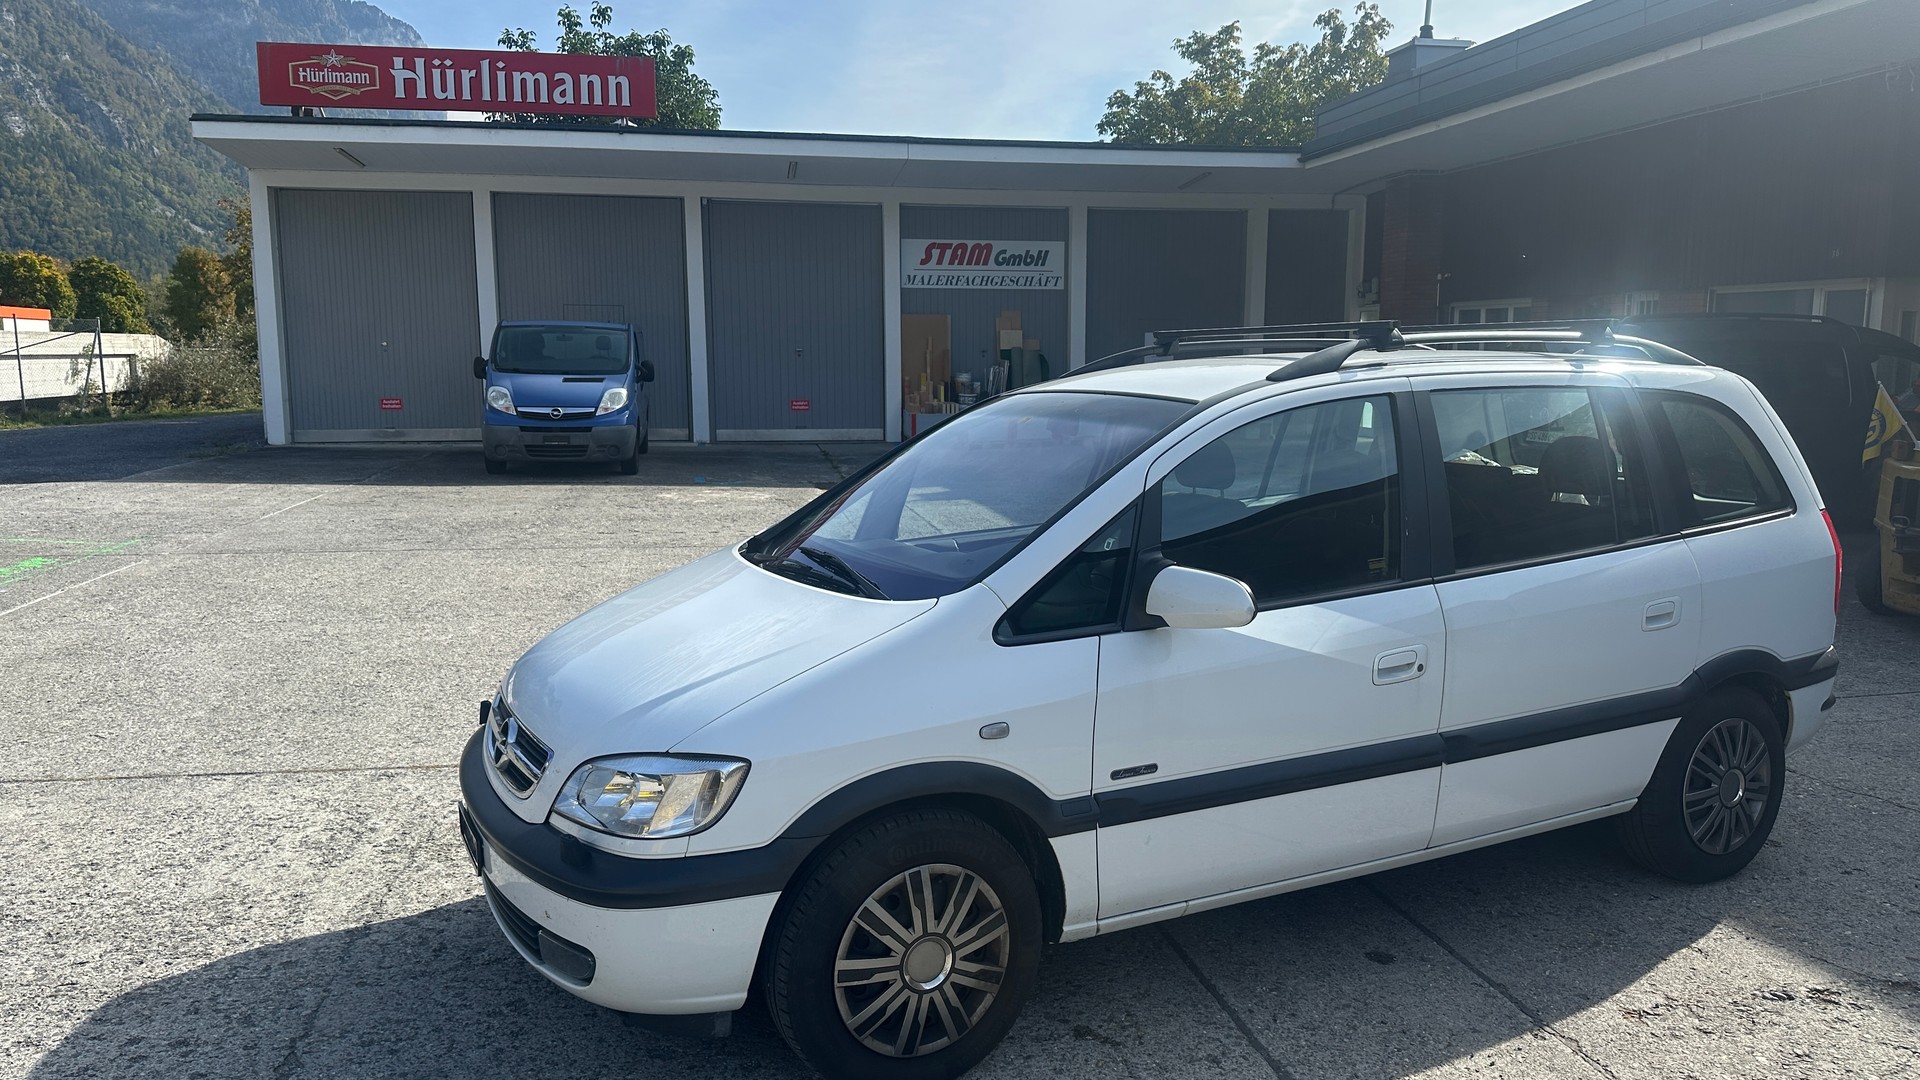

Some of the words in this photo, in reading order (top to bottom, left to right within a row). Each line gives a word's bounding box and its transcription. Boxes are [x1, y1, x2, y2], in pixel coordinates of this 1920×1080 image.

[298, 67, 370, 84] Hürlimann
[390, 57, 631, 107] Hürlimann
[919, 242, 994, 266] STAM
[994, 249, 1050, 267] GmbH
[904, 273, 1062, 287] MALERFACHGESCHÄFT
